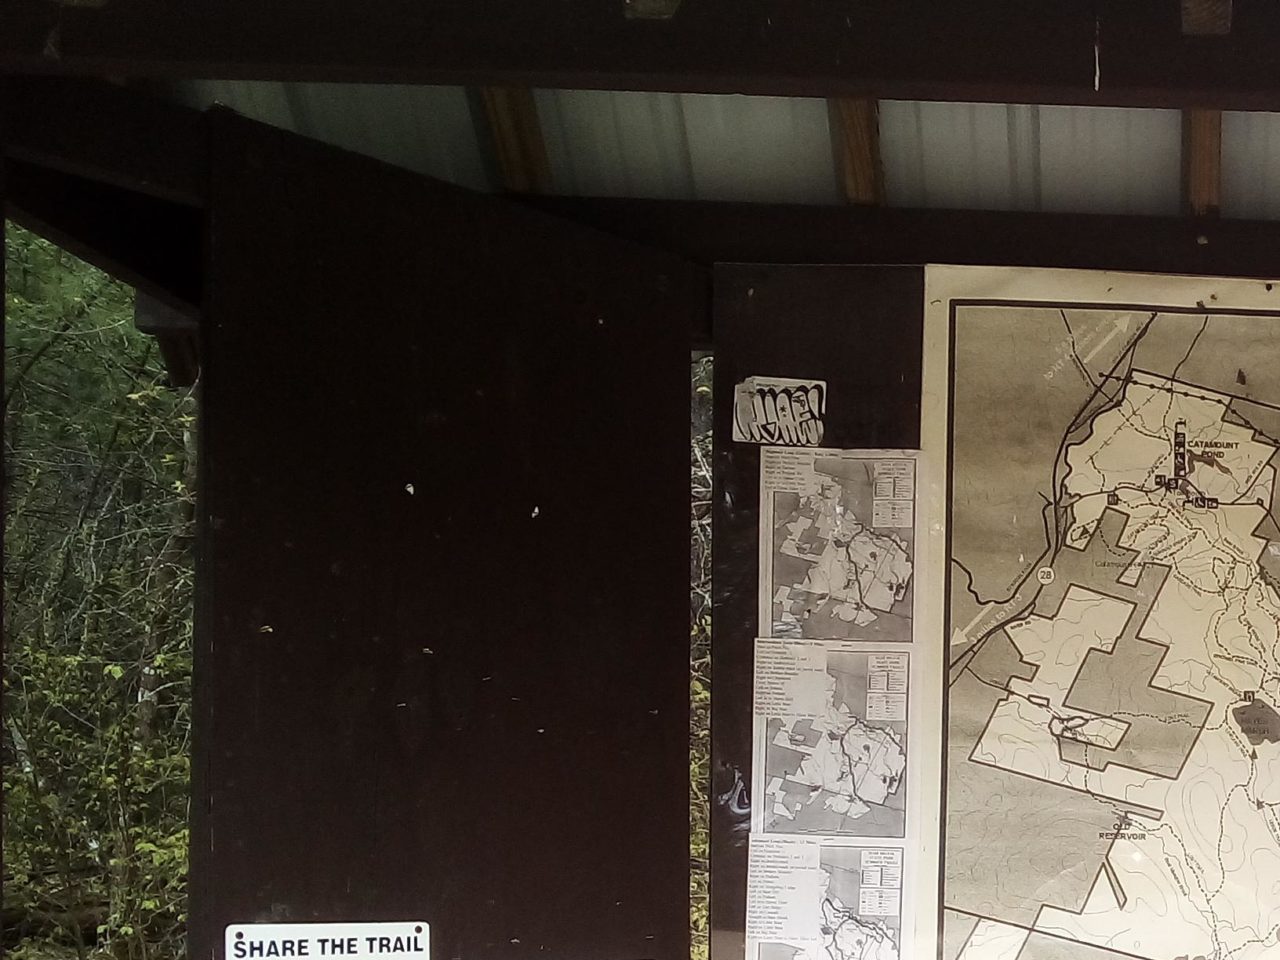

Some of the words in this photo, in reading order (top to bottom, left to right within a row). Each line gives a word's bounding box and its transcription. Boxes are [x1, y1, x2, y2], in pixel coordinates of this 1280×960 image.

[1187, 441, 1240, 450] CATAMOUNT
[1201, 450, 1226, 459] POND
[1040, 570, 1052, 579] 28
[233, 939, 310, 959] SHARE
[317, 938, 358, 955] THE
[365, 936, 424, 953] TRAIL
